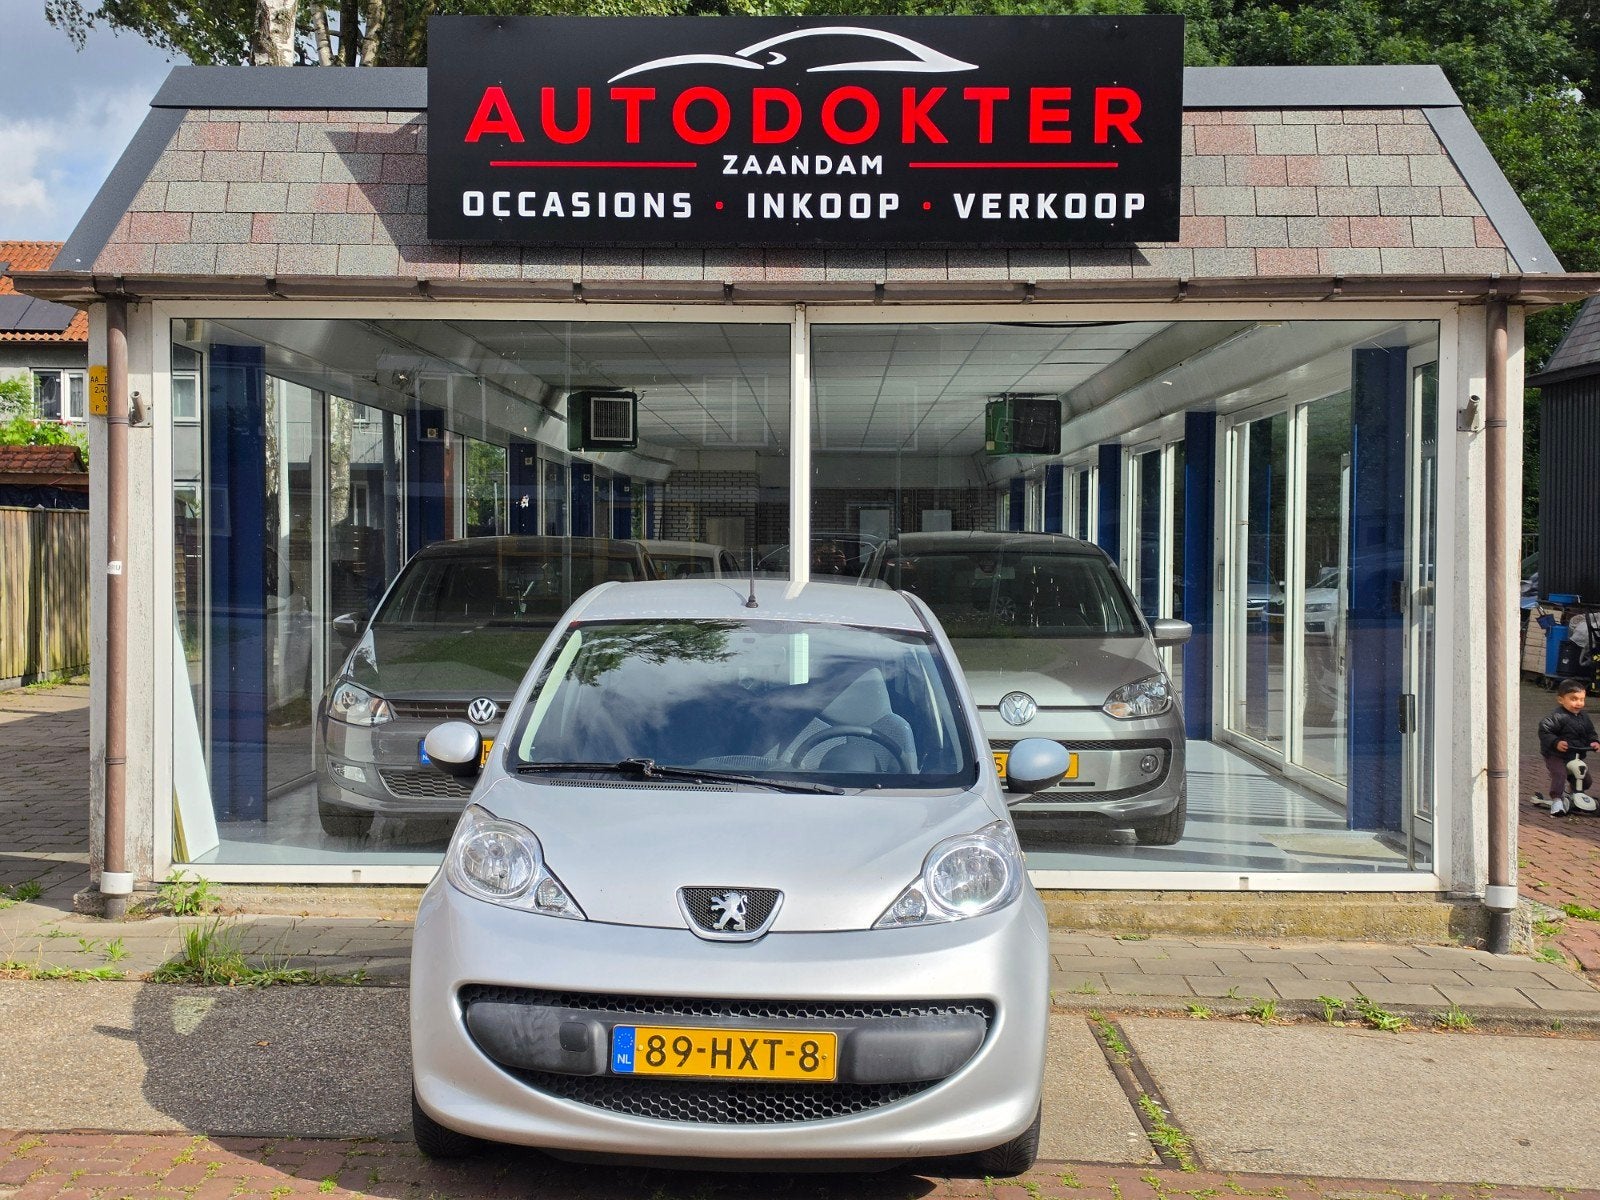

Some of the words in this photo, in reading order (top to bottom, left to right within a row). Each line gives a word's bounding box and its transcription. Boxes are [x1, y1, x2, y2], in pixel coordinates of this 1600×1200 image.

[464, 86, 1143, 145] AUTODOKTER
[722, 154, 883, 175] ZAANDAM
[462, 190, 692, 218] OCCASIONS
[747, 192, 899, 219] INKOOP
[953, 192, 1145, 219] VERKOOP
[617, 1053, 632, 1065] NL
[645, 1034, 820, 1073] 89-HXT-8
